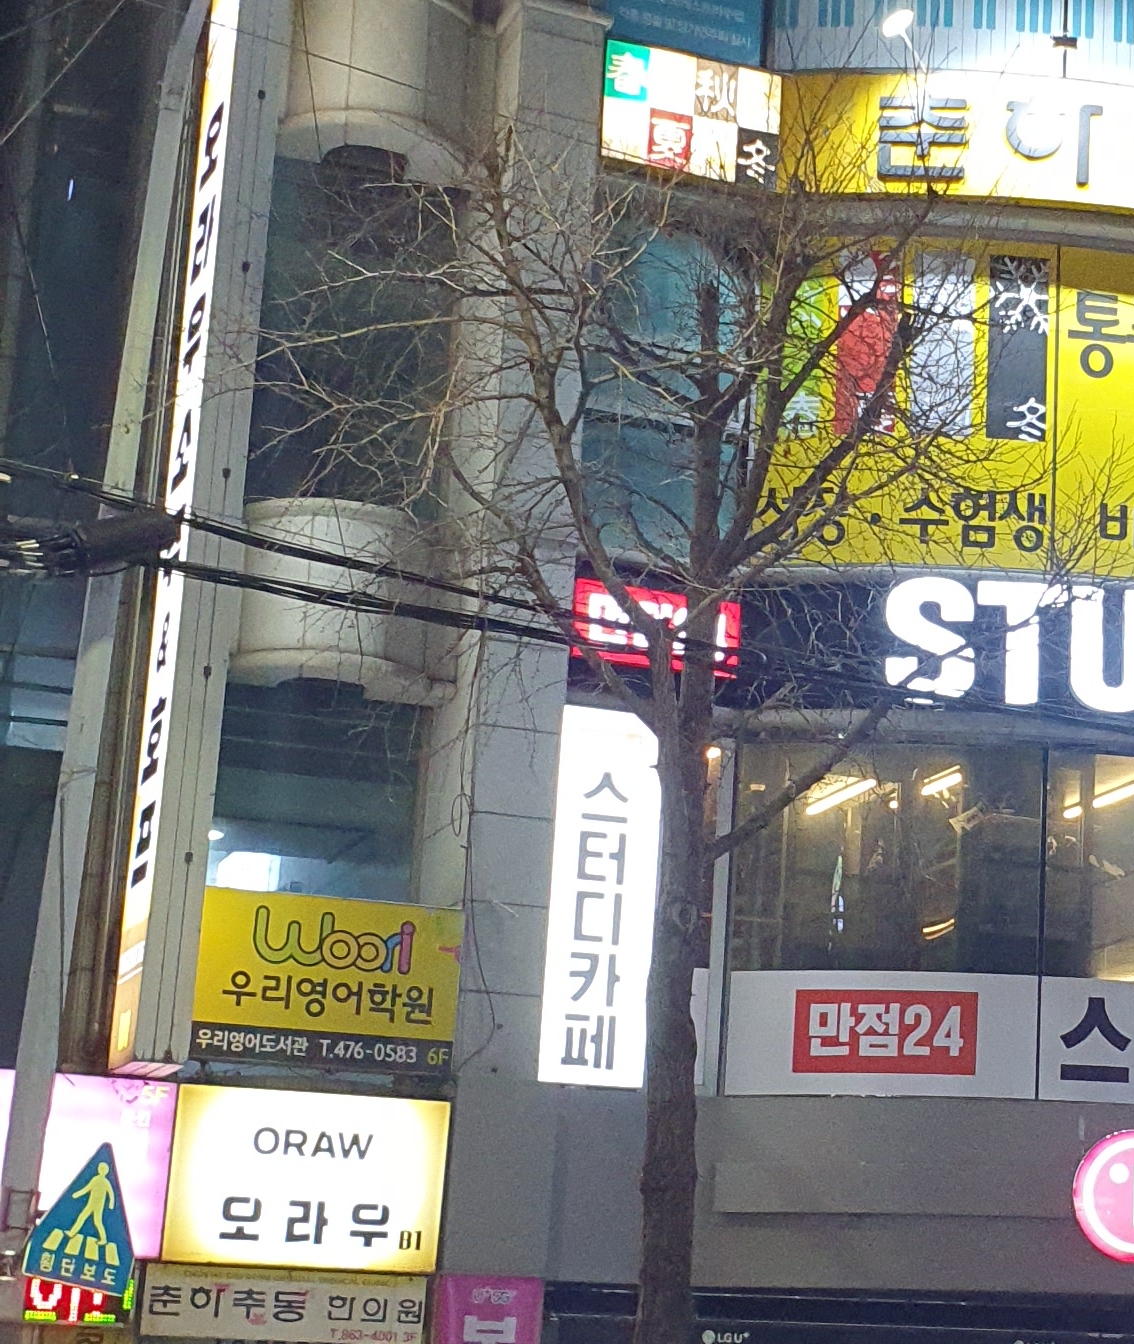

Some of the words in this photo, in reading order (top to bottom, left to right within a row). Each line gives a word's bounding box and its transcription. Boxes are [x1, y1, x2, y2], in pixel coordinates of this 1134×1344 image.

[899, 491, 1047, 553] 수험생
[559, 771, 630, 1071] 스터디카페
[221, 970, 434, 1026] 우리영어학원
[196, 1028, 309, 1058] 우리영어도서관
[319, 1039, 418, 1065] T.476-0583
[426, 1047, 449, 1067] 6F
[808, 1002, 965, 1058] 만점24
[253, 1126, 374, 1161] ORAW
[218, 1195, 391, 1249] 오라우
[39, 1251, 117, 1287] 횡단보도
[149, 1284, 307, 1323] 춘하추동
[326, 1294, 423, 1325] 한의원
